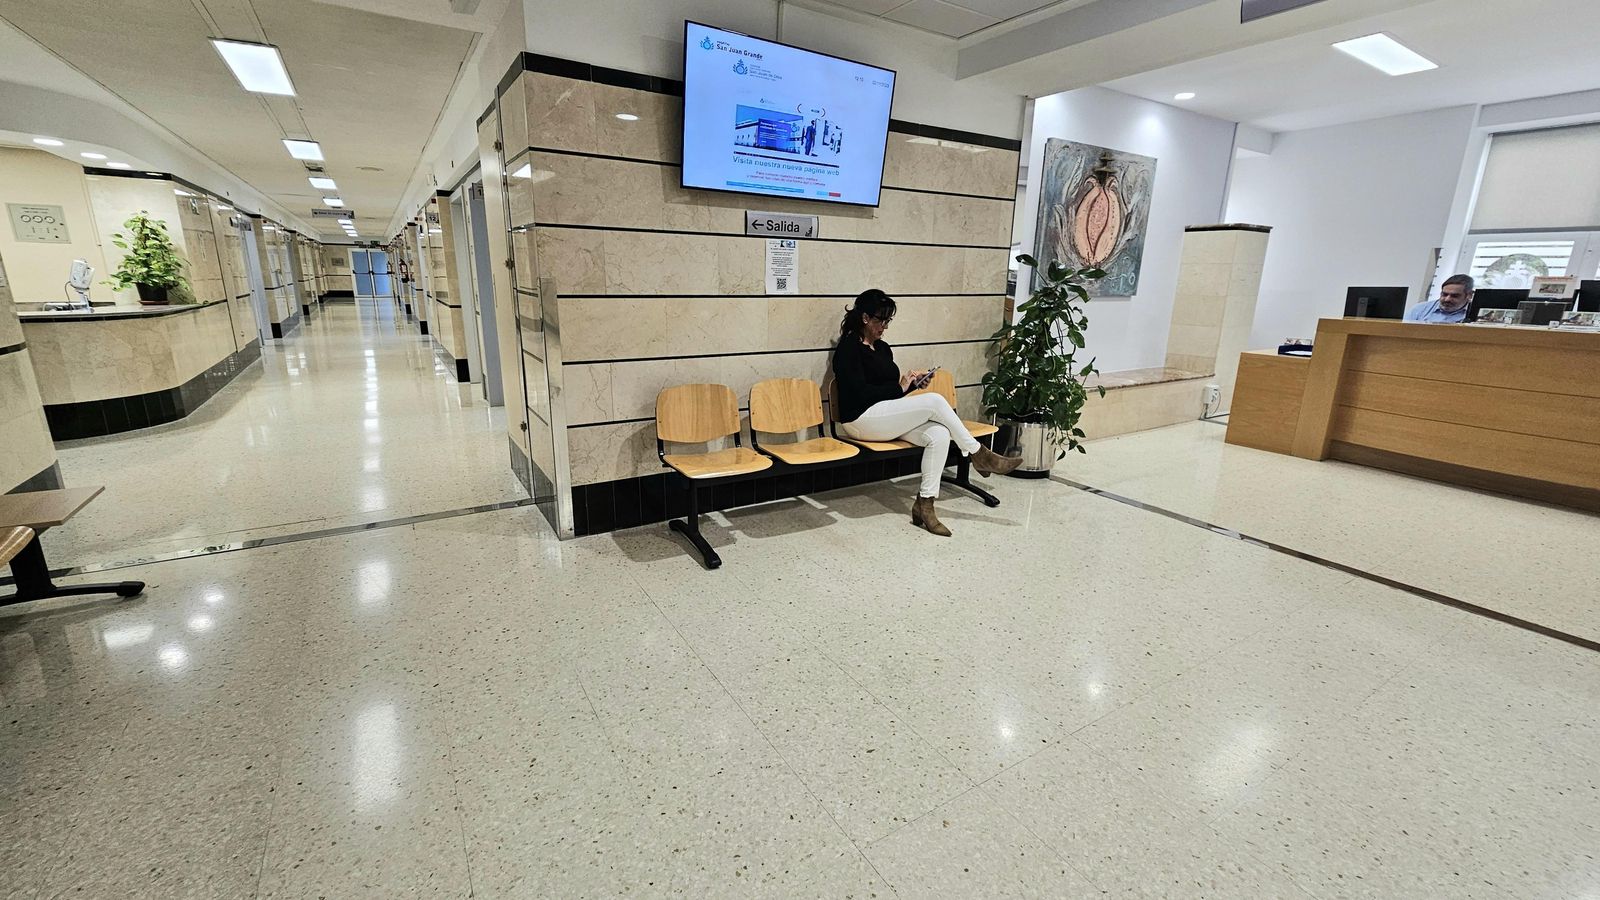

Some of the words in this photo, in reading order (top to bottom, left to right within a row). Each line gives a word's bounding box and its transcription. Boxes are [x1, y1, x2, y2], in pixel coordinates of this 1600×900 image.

[716, 43, 728, 51] San
[729, 47, 743, 55] Juan
[743, 50, 763, 59] Grande
[732, 156, 753, 165] Visita
[754, 160, 781, 169] nuestra
[782, 163, 802, 171] nueva
[766, 219, 800, 233] Salida
